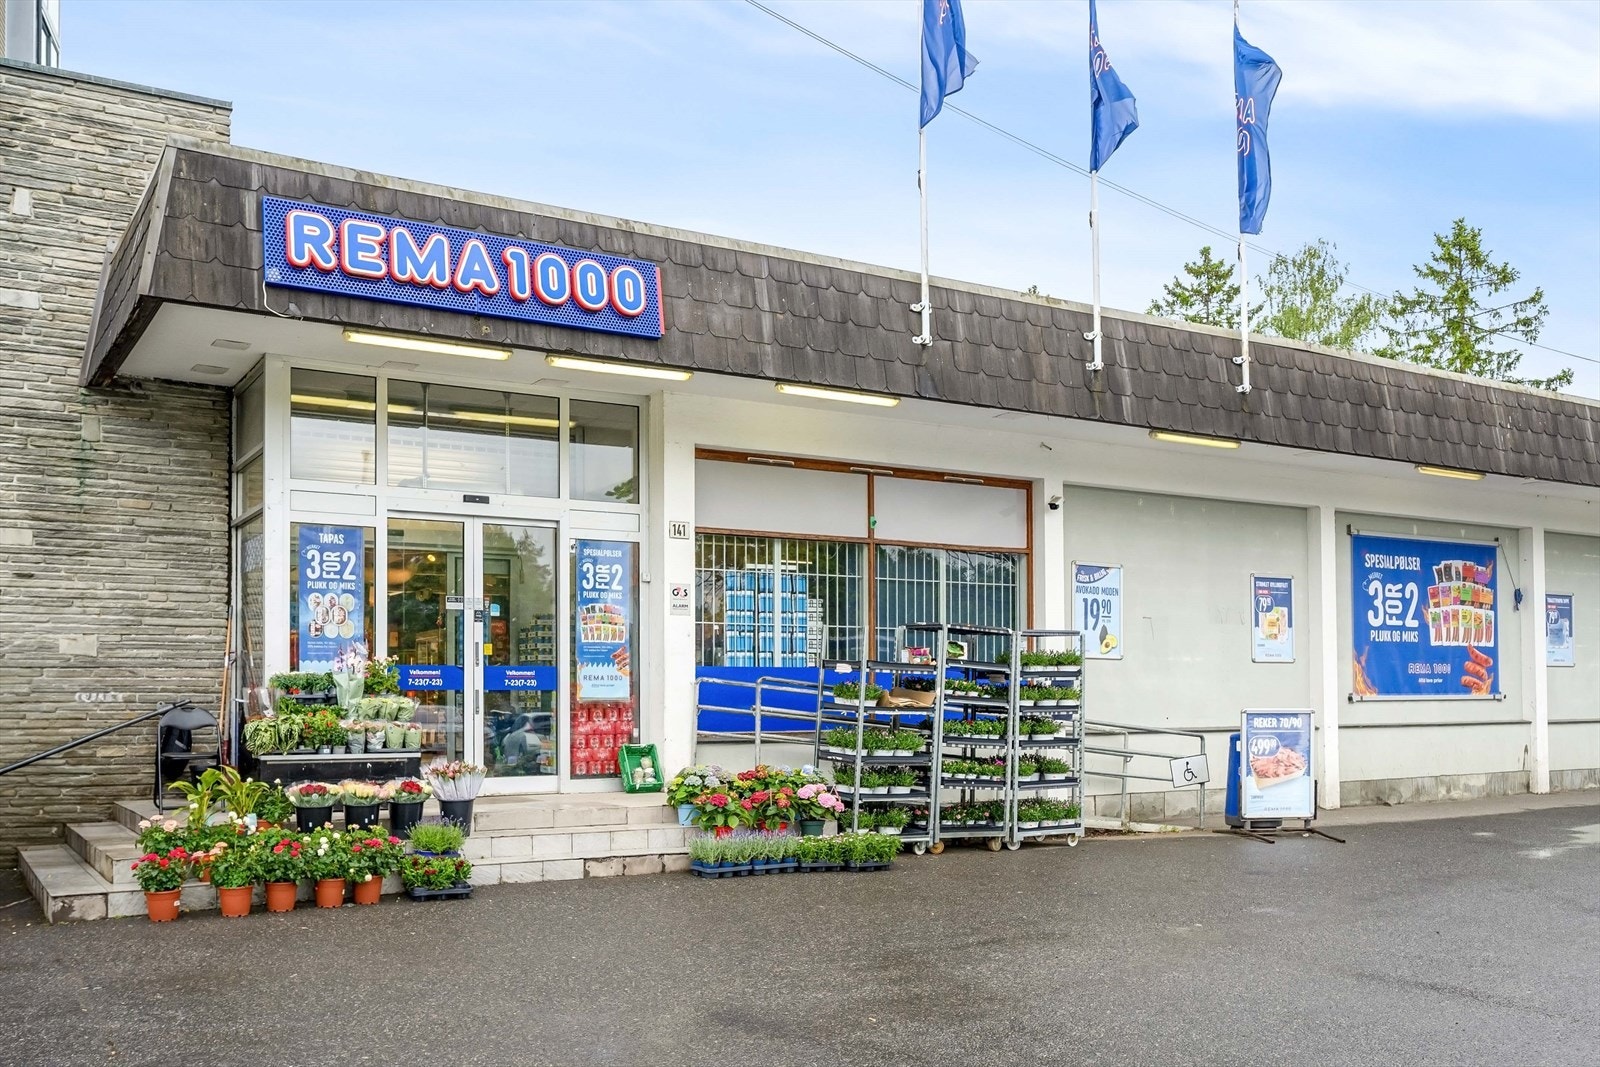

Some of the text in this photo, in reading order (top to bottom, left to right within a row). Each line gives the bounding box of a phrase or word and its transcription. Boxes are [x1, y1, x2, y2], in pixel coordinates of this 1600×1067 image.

[286, 210, 646, 318] REMA 1000
[672, 524, 686, 536] 141
[319, 533, 344, 544] TAPAS
[306, 549, 357, 580] 3 FOR 2
[1365, 553, 1421, 571] SPESIALPØLSER
[582, 562, 623, 591] 3 FOR 2
[307, 581, 356, 590] PLUKK OG MIKS
[1075, 585, 1119, 597] AVOKADO MODEN
[583, 591, 623, 600] PLUKK OG MIKS
[1367, 580, 1420, 628] 3 FOR 2
[1082, 598, 1112, 631] 19 90
[1370, 629, 1419, 643] PLUKK OG MIKS
[1253, 717, 1302, 729] REKER 70/90
[1250, 738, 1270, 755] 499
